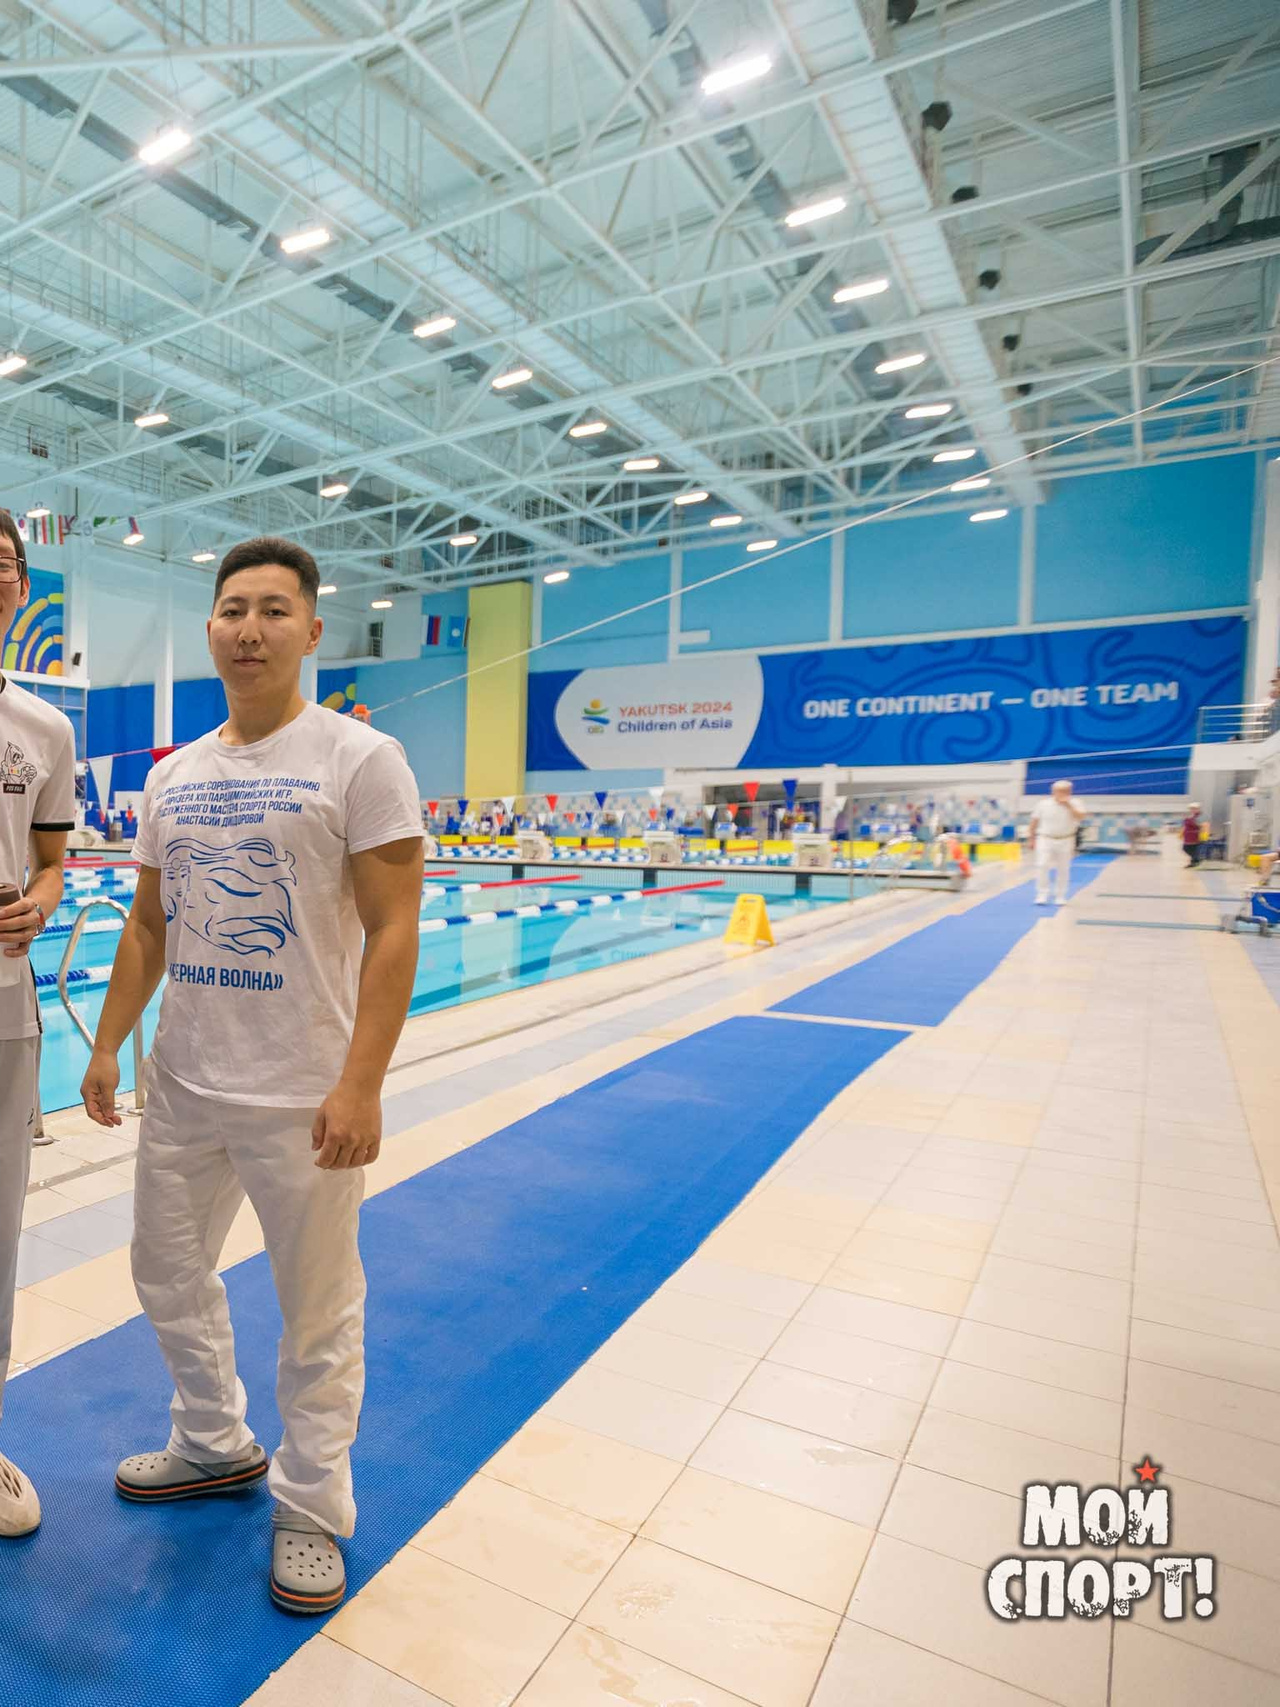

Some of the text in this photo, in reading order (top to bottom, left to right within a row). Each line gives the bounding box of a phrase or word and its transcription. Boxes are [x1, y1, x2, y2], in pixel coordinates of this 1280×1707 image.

[619, 700, 733, 718] YAKUTSK 2024
[803, 698, 850, 720] ONE
[855, 691, 993, 718] CONTINENT
[1030, 686, 1088, 709] ONE
[1096, 681, 1179, 705] TEAM
[617, 718, 677, 734] Children
[681, 718, 695, 730] of
[700, 716, 733, 730] Asia
[272, 777, 320, 792] ПЛАВАНИЮ
[239, 800, 267, 812] СПОРТА
[268, 799, 303, 814] РОССИИ
[175, 814, 221, 827] АНАСТАСИИ
[219, 967, 284, 992] ВОЛНА»
